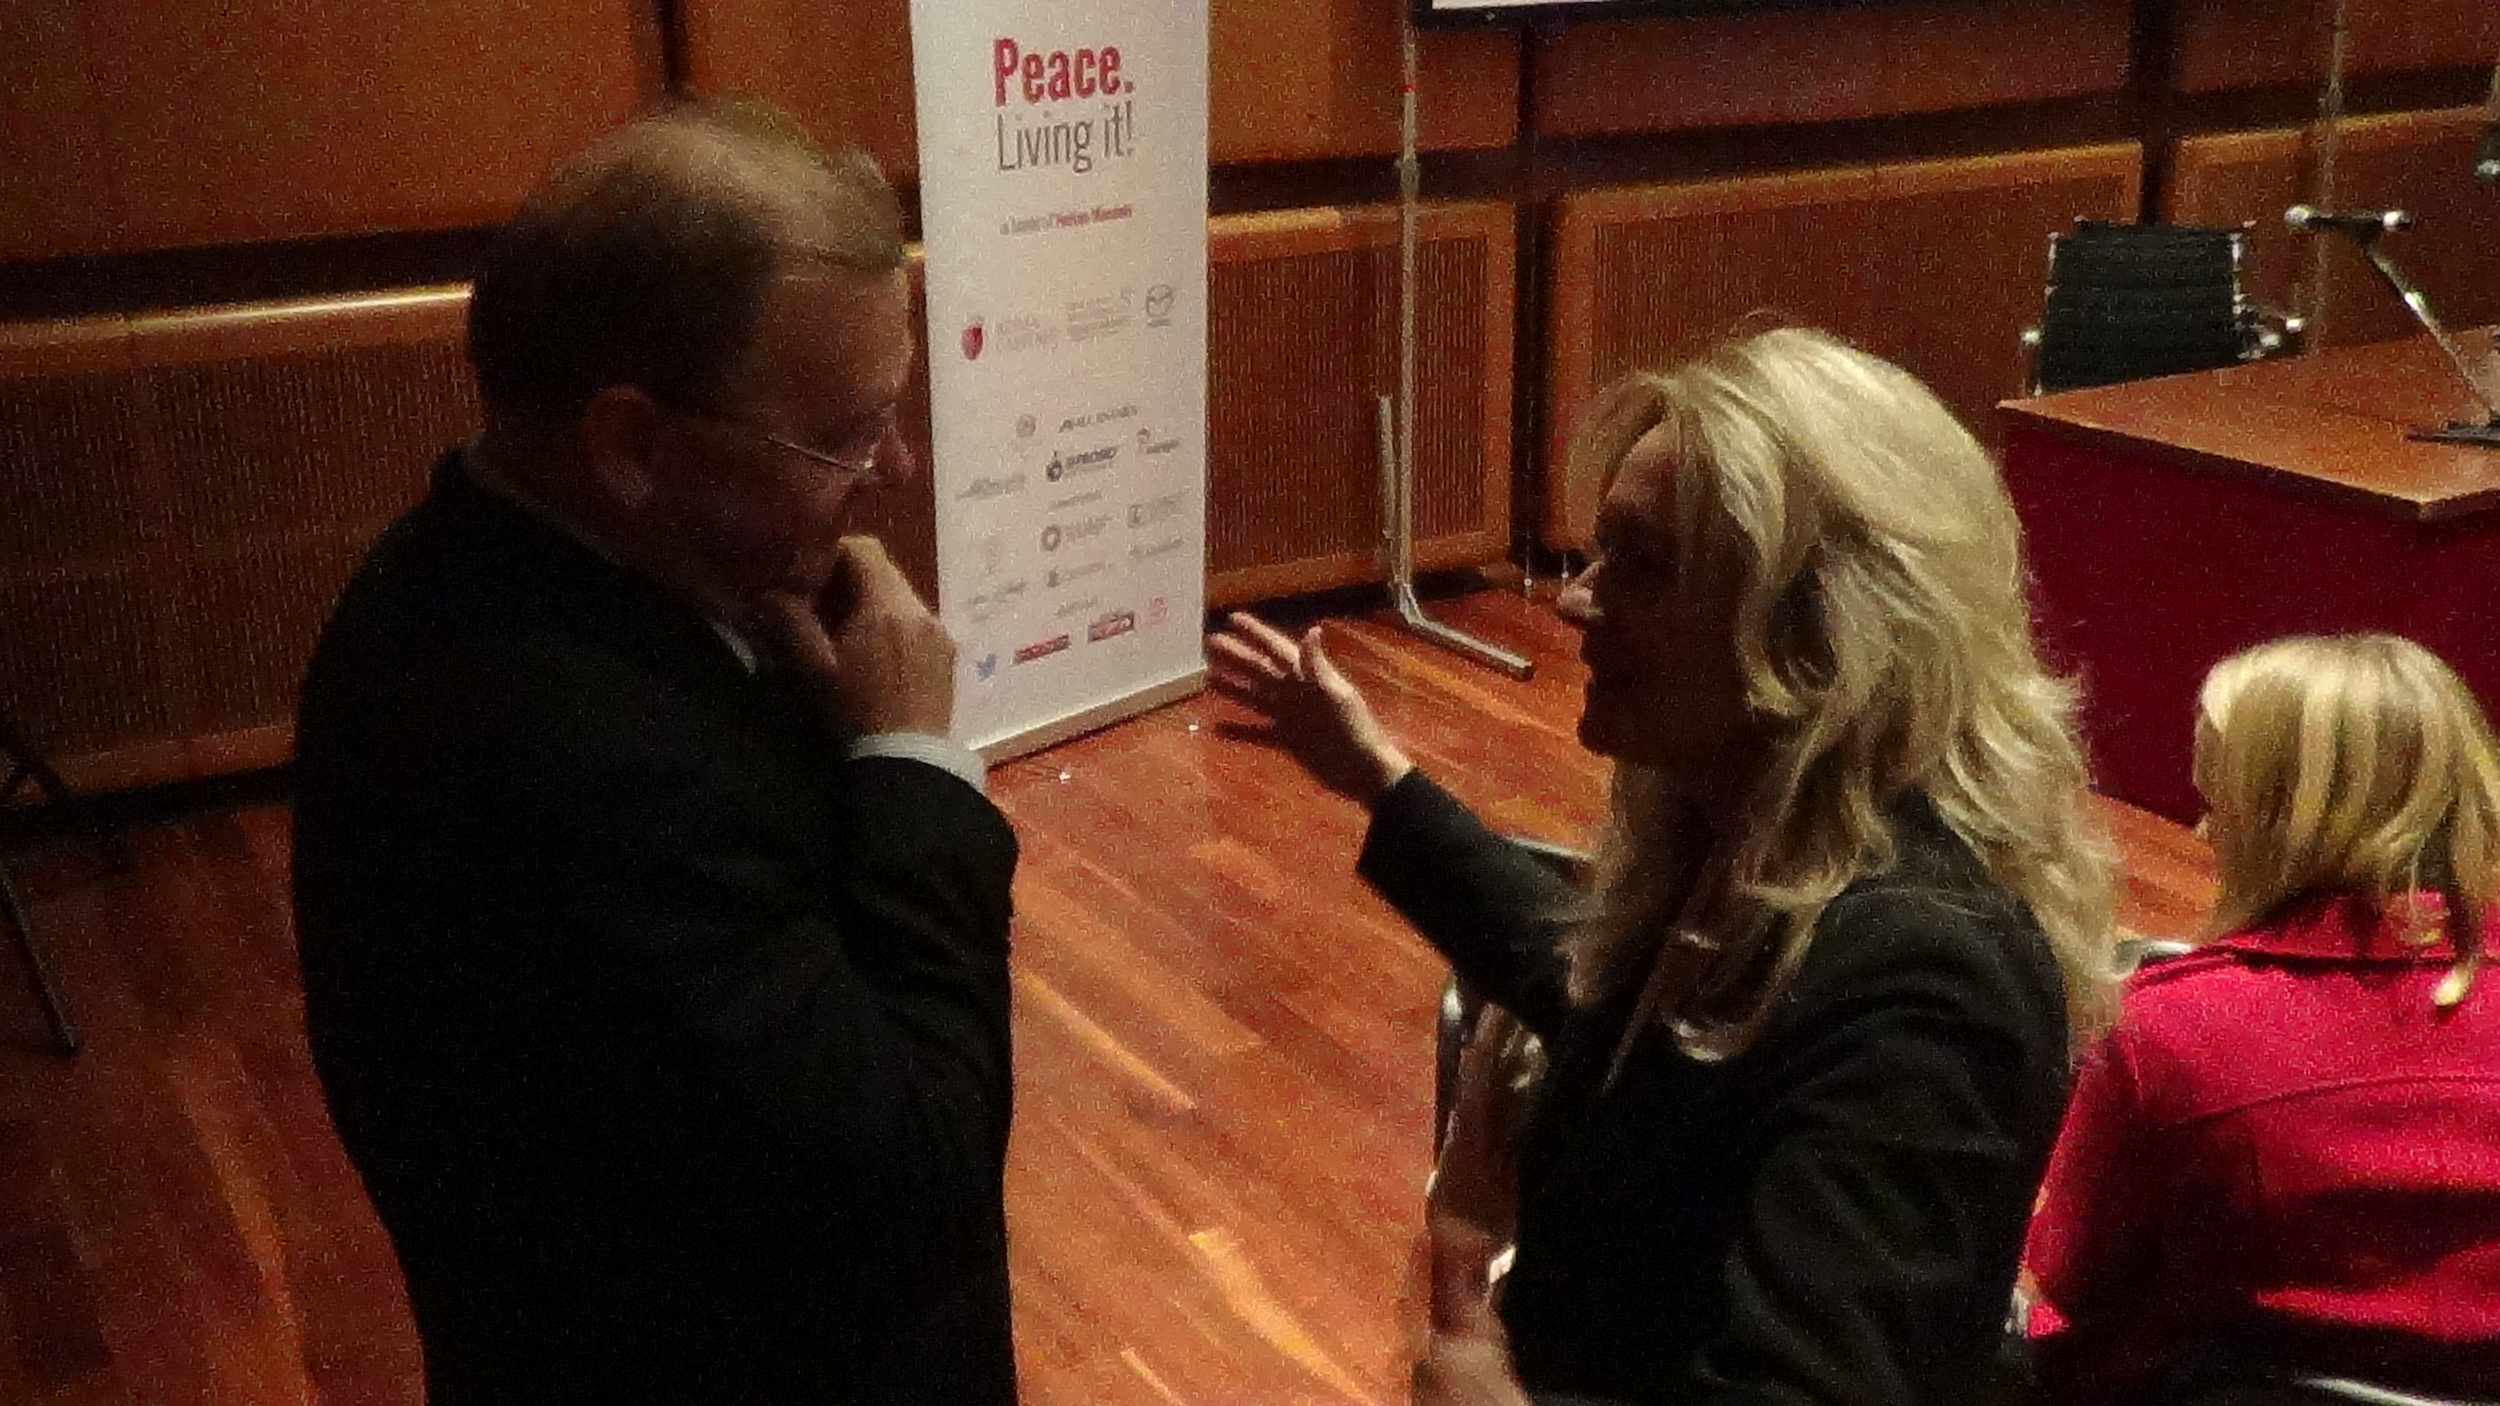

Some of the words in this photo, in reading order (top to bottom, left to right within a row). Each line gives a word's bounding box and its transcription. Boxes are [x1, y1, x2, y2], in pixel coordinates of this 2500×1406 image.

[994, 38, 1135, 107] Peace.
[997, 111, 1094, 173] Living
[1102, 99, 1135, 159] it!
